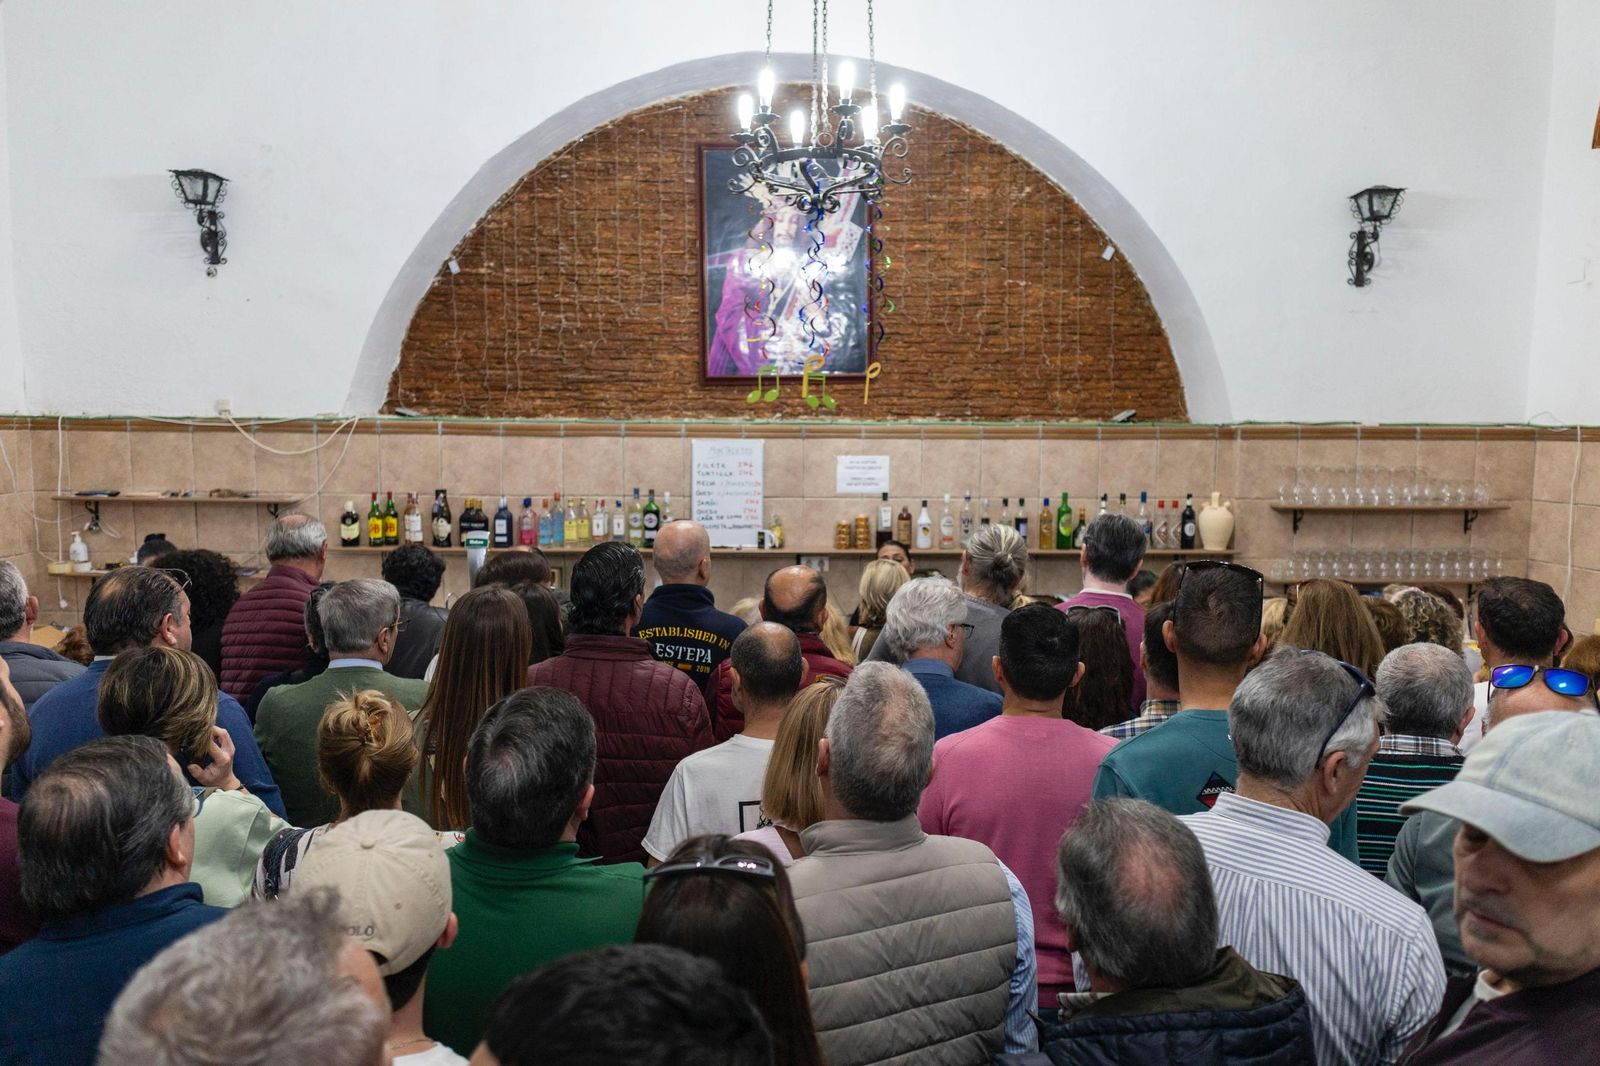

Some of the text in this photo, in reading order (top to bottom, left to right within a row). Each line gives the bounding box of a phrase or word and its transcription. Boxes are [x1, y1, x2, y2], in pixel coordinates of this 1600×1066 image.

[638, 626, 730, 650] ESTABLISHED IN
[655, 642, 712, 664] ESTEPA
